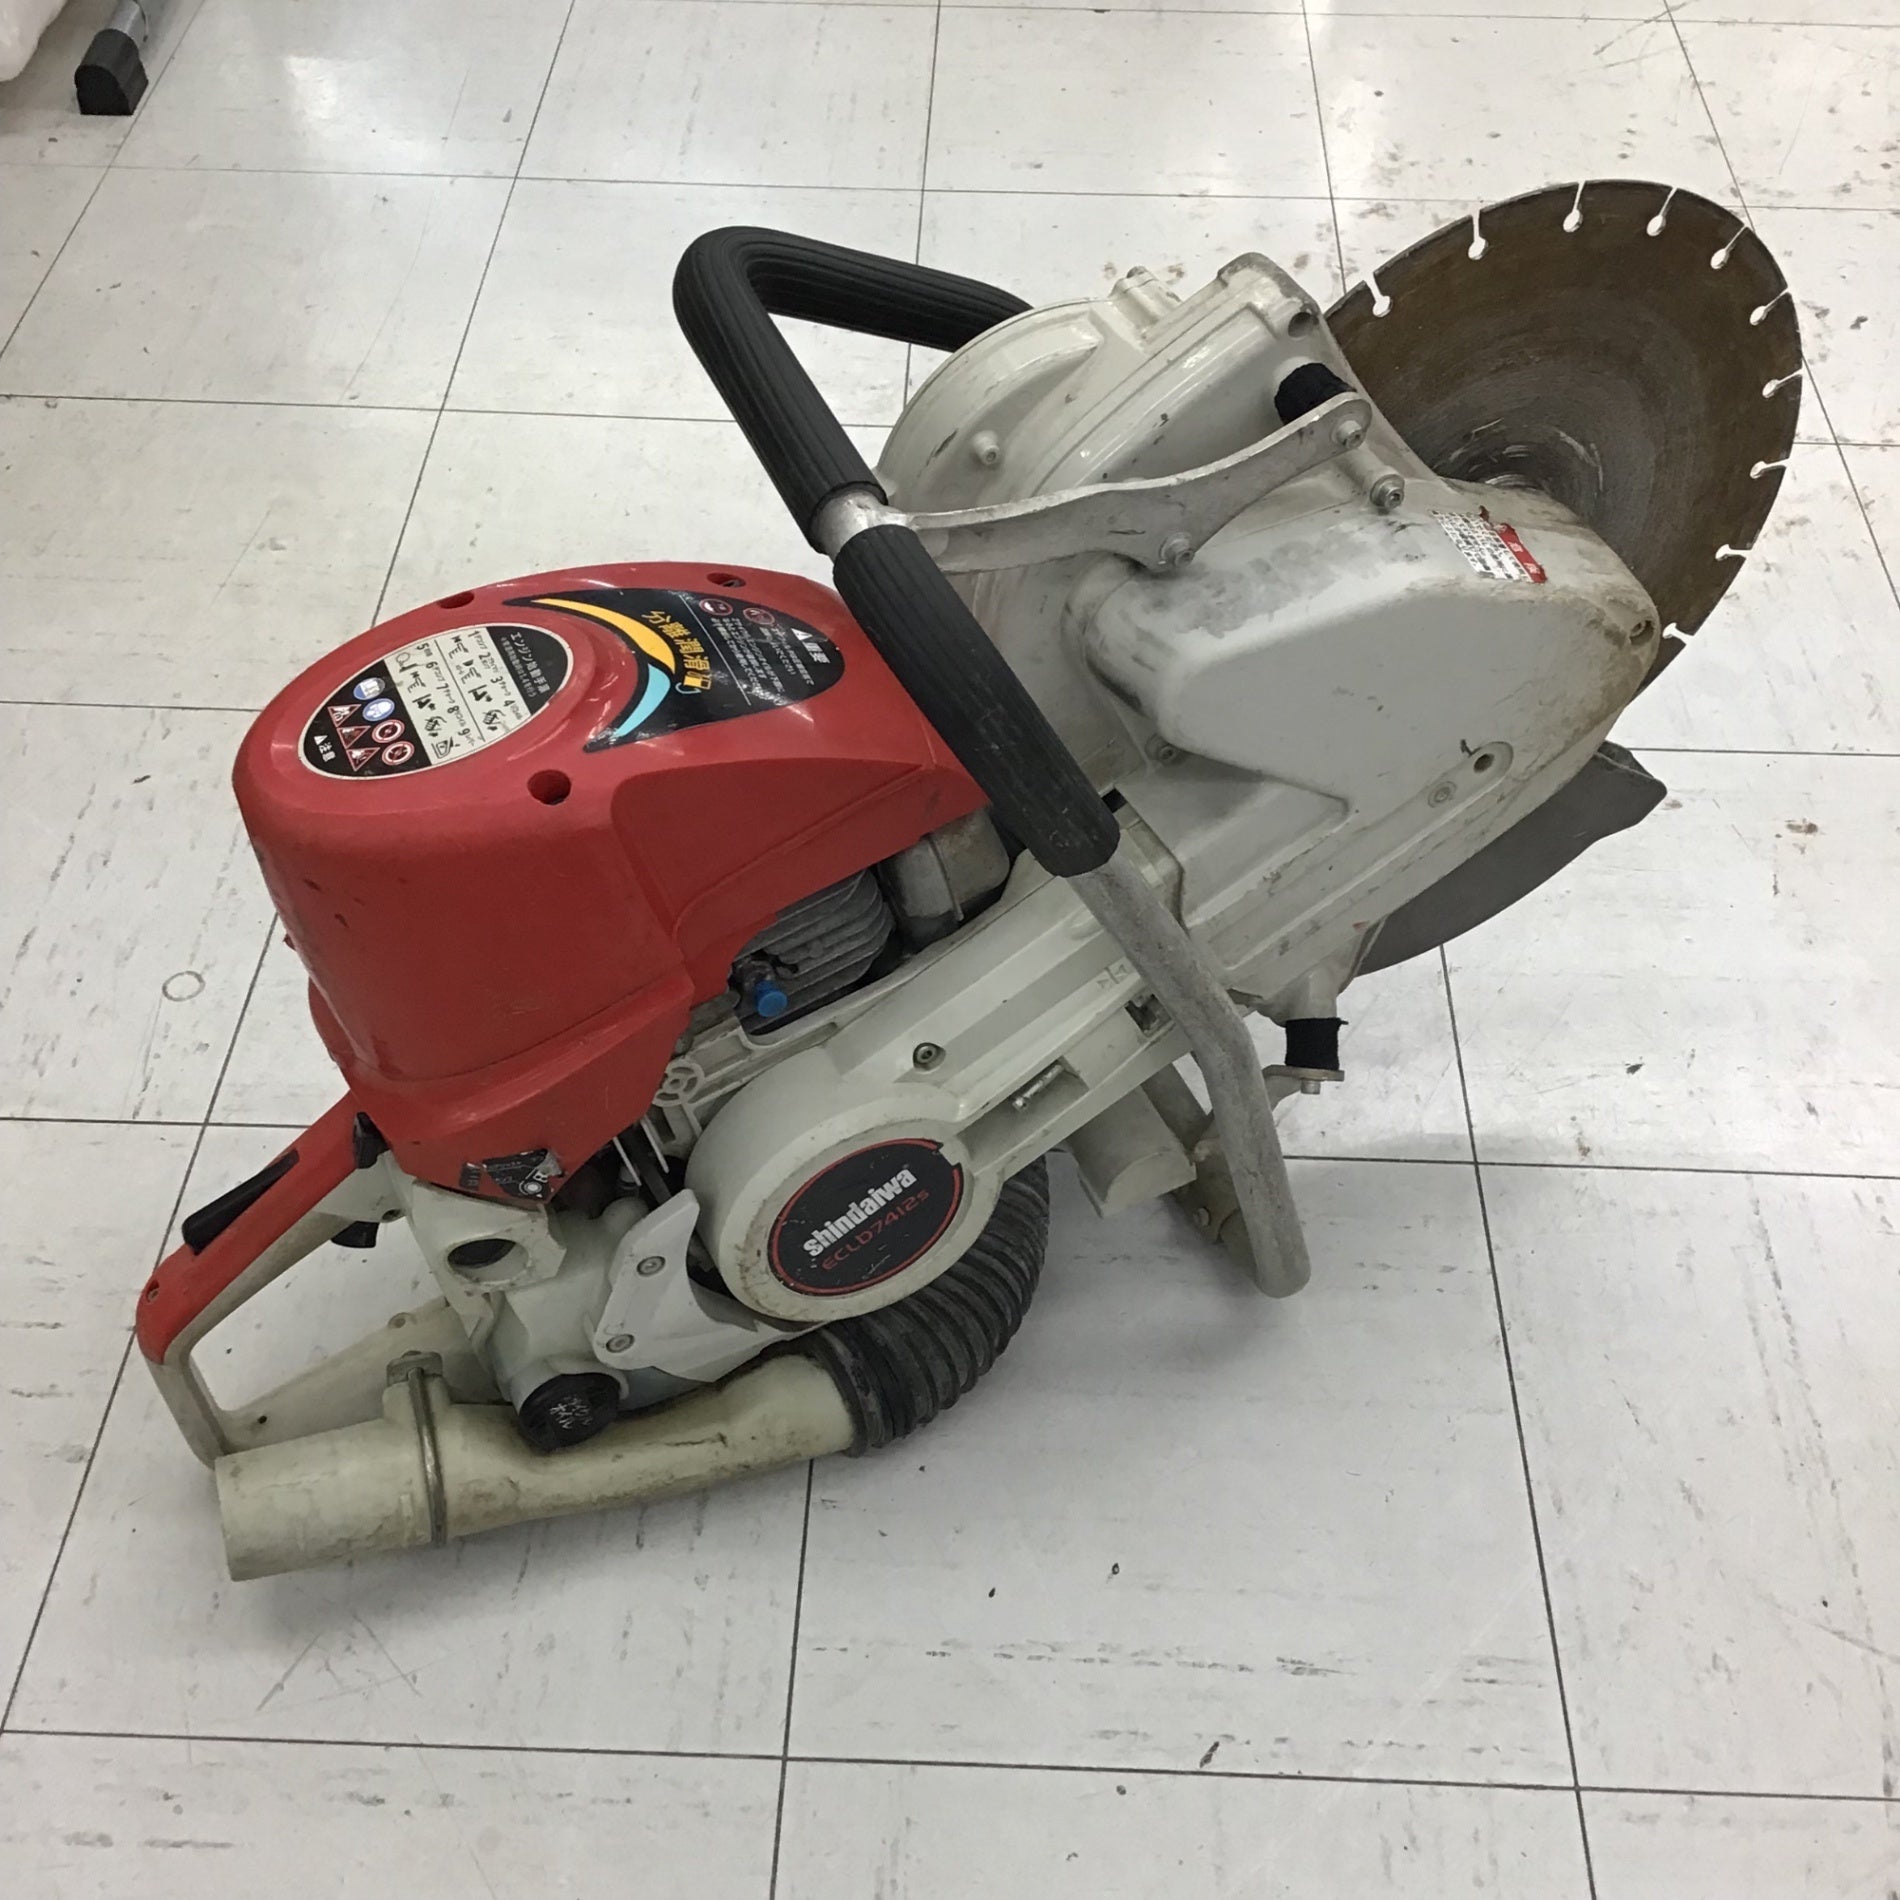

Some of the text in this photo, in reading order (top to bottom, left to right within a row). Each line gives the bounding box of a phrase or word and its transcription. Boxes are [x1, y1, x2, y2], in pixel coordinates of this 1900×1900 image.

[478, 650, 490, 660] 2
[490, 674, 504, 683] 3
[503, 699, 516, 707] 4
[641, 610, 711, 672] 分離潤滑
[416, 642, 430, 651] 5
[425, 660, 438, 669] 6
[436, 682, 449, 690] 7
[446, 704, 460, 713] 8
[457, 727, 470, 735] 9
[803, 1168, 917, 1257] shindaiwa
[822, 1189, 930, 1271] ECLD7412s
